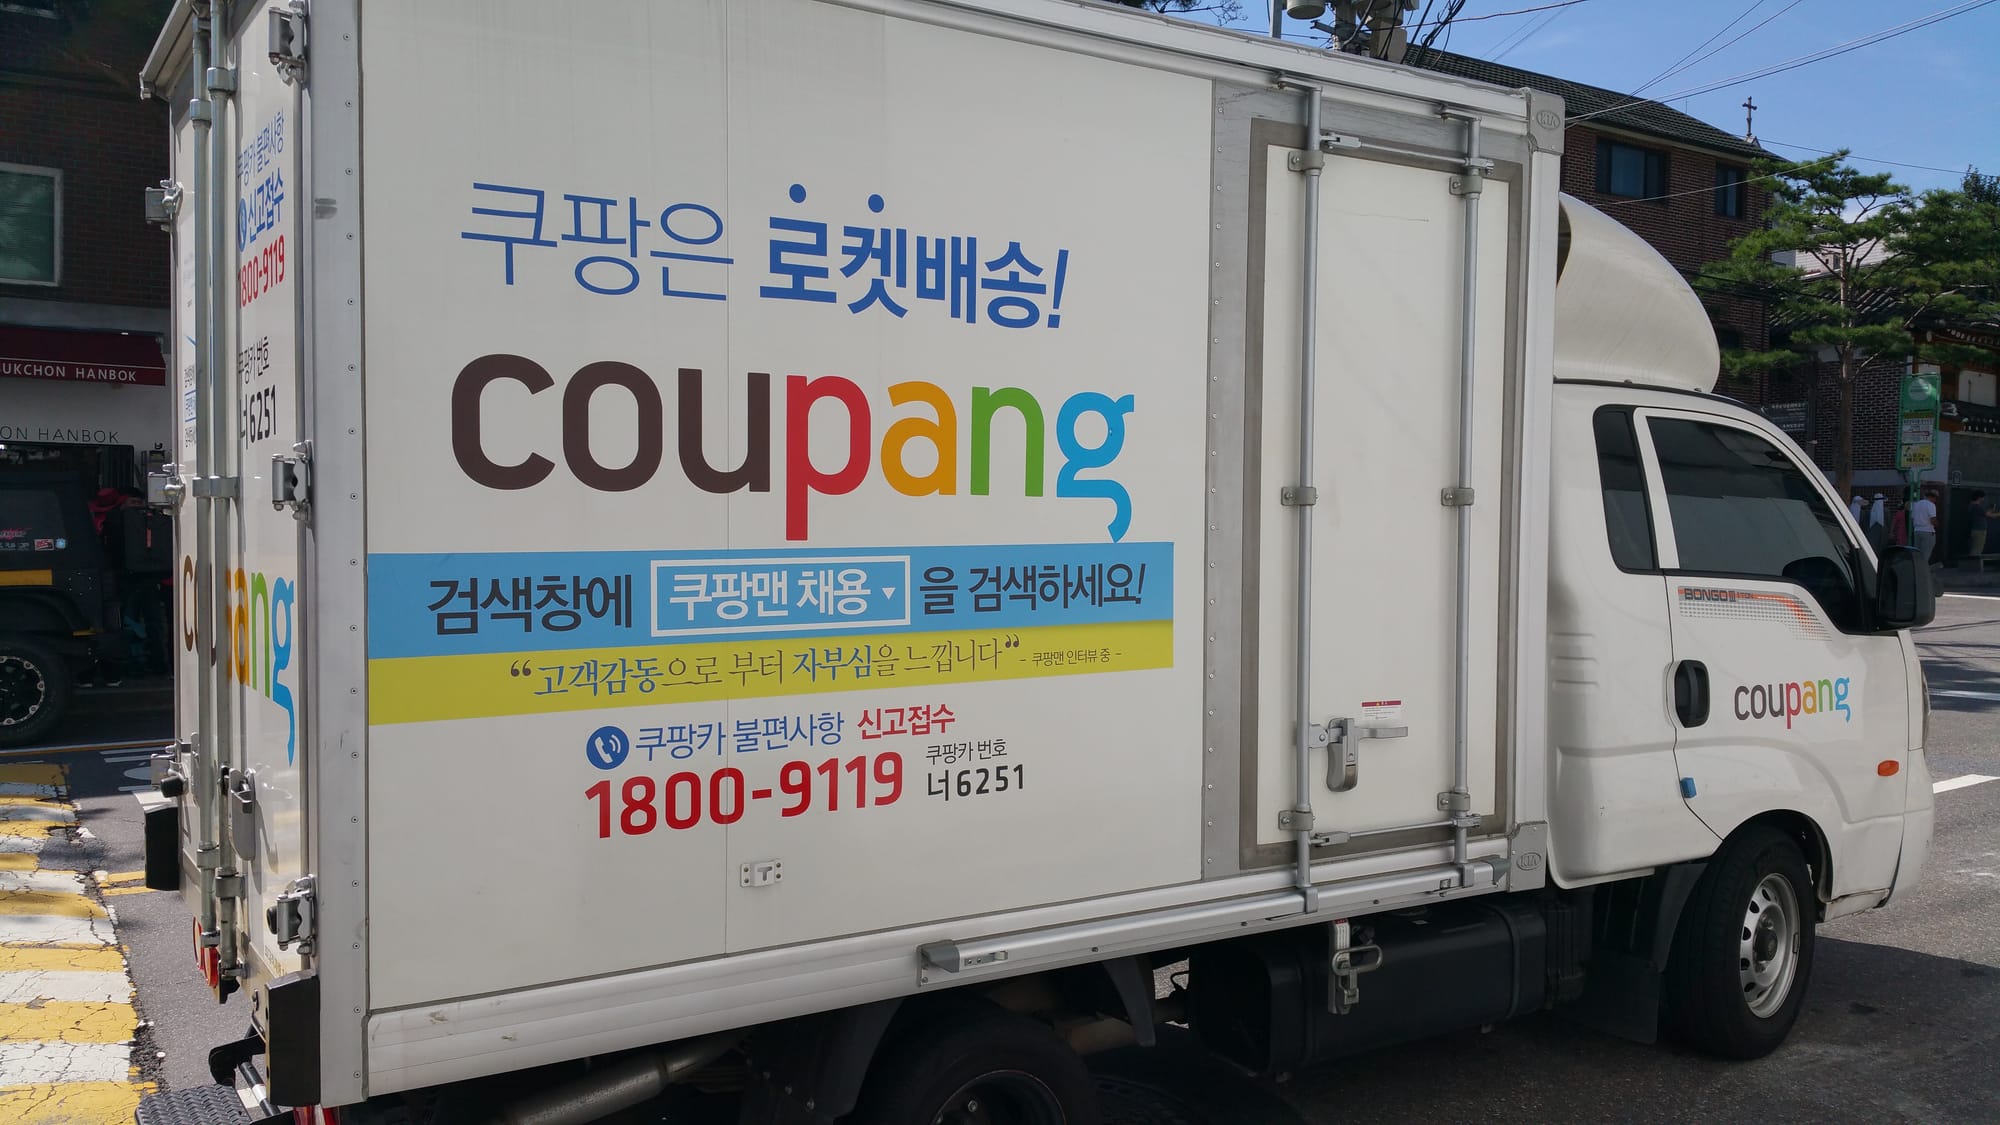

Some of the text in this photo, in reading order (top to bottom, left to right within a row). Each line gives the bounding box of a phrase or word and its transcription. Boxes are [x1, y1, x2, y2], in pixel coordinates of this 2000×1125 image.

[257, 108, 285, 173] 불편사항
[248, 167, 285, 243] 신고접수
[237, 234, 285, 309] 1800-9119
[461, 182, 1070, 329] 쿠팡은 로켓배송!
[0, 362, 137, 382] UKCHON HANBOK
[257, 336, 270, 376] 번호
[38, 428, 120, 444] HANBOK
[451, 354, 1136, 544] coupang
[427, 563, 1146, 635] 검색창에 쿠팡맨 채용 을 검색하세요!
[1684, 587, 1728, 602] BONGO
[183, 554, 296, 768] cang
[728, 650, 784, 688] 부터
[791, 643, 900, 684] 자부심을
[1031, 650, 1064, 667] 쿠팡맨
[1066, 649, 1099, 665] 인터뷰
[1100, 648, 1111, 663] 중
[1733, 676, 1852, 730] coupang
[634, 704, 956, 761] 쿠팡카 불편사항 신고접수
[925, 738, 1008, 766] 쿠팡카 번호
[583, 751, 904, 839] 1800-9119
